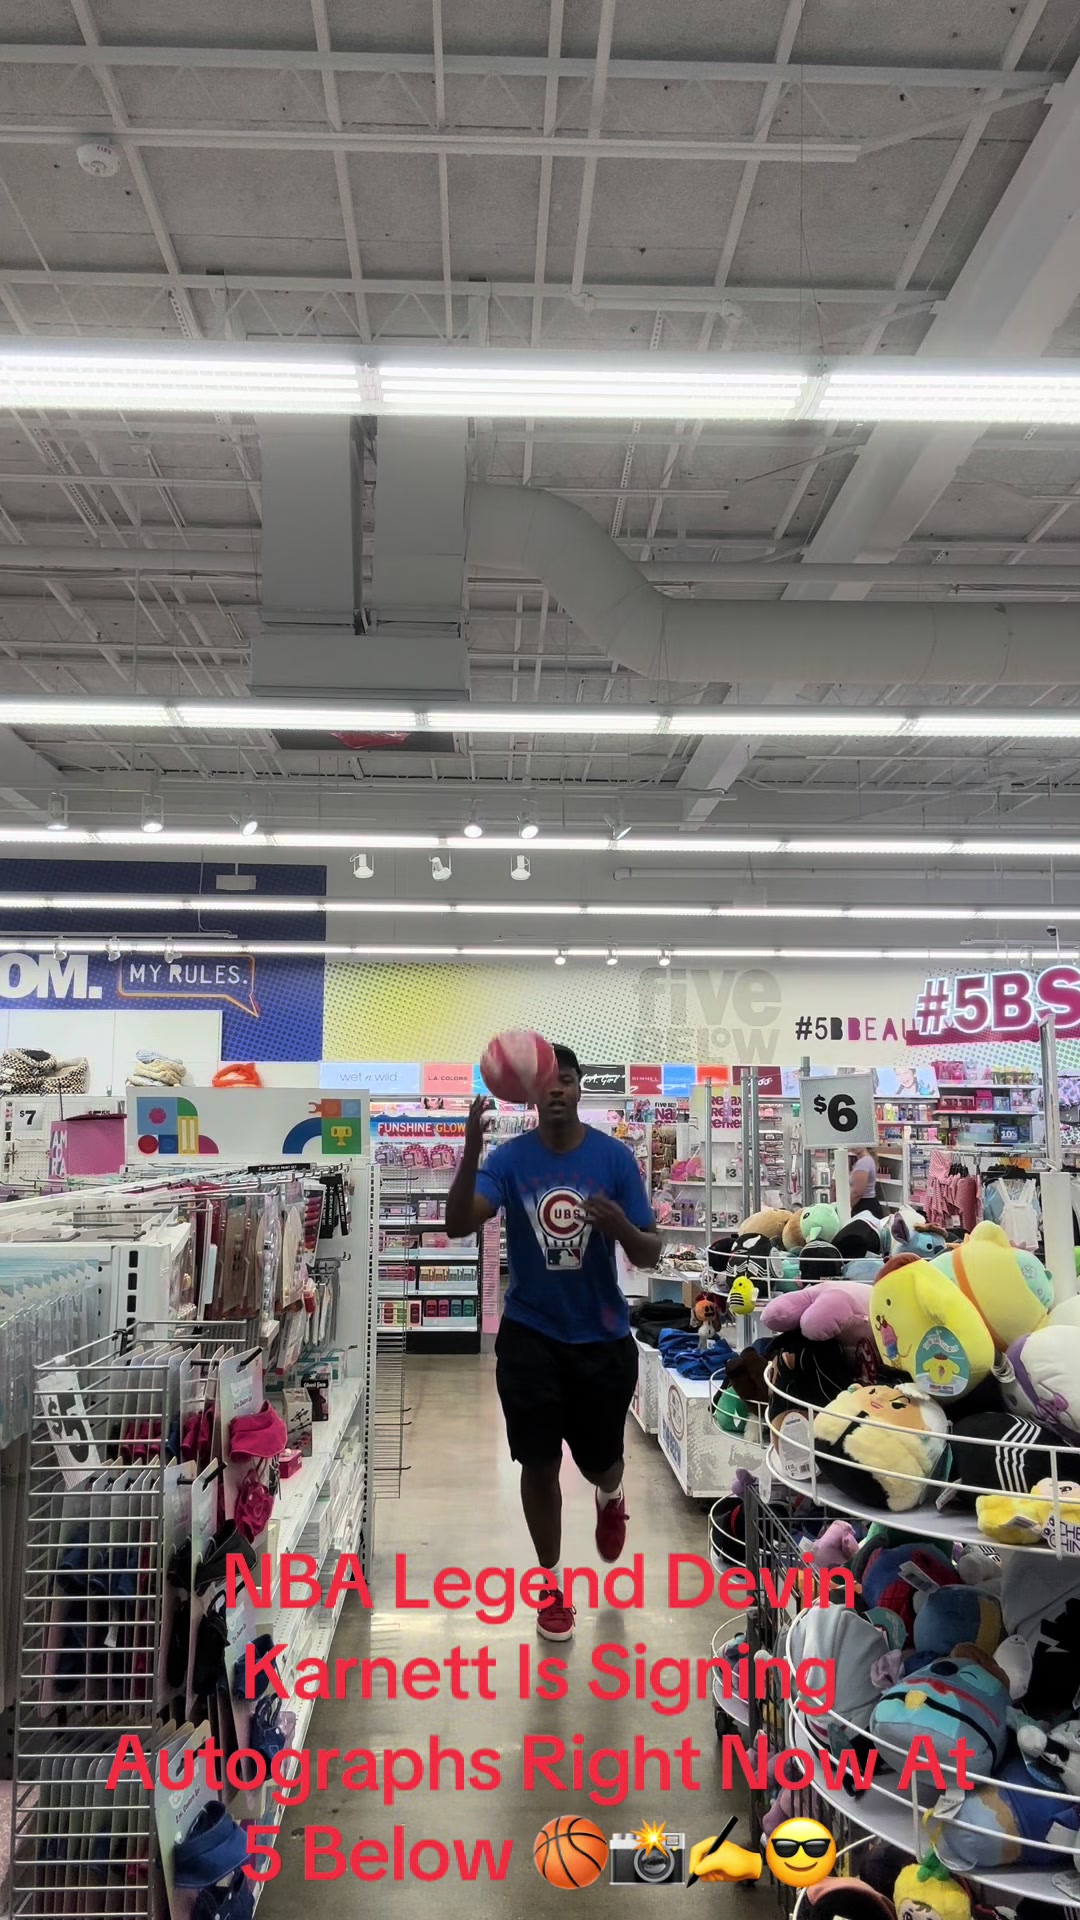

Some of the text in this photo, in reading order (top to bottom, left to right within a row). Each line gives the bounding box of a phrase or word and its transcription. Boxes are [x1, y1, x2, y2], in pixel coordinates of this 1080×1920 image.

[129, 964, 248, 985] MY RULES.
[633, 966, 783, 1027] five
[795, 1016, 917, 1041] #5BBEAU
[340, 1072, 363, 1082] wet
[373, 1071, 399, 1082] wild
[19, 1110, 36, 1125] $7
[813, 1094, 858, 1132] $6
[377, 1122, 466, 1136] FUNSHINE GLOW
[47, 1387, 90, 1464] $5
